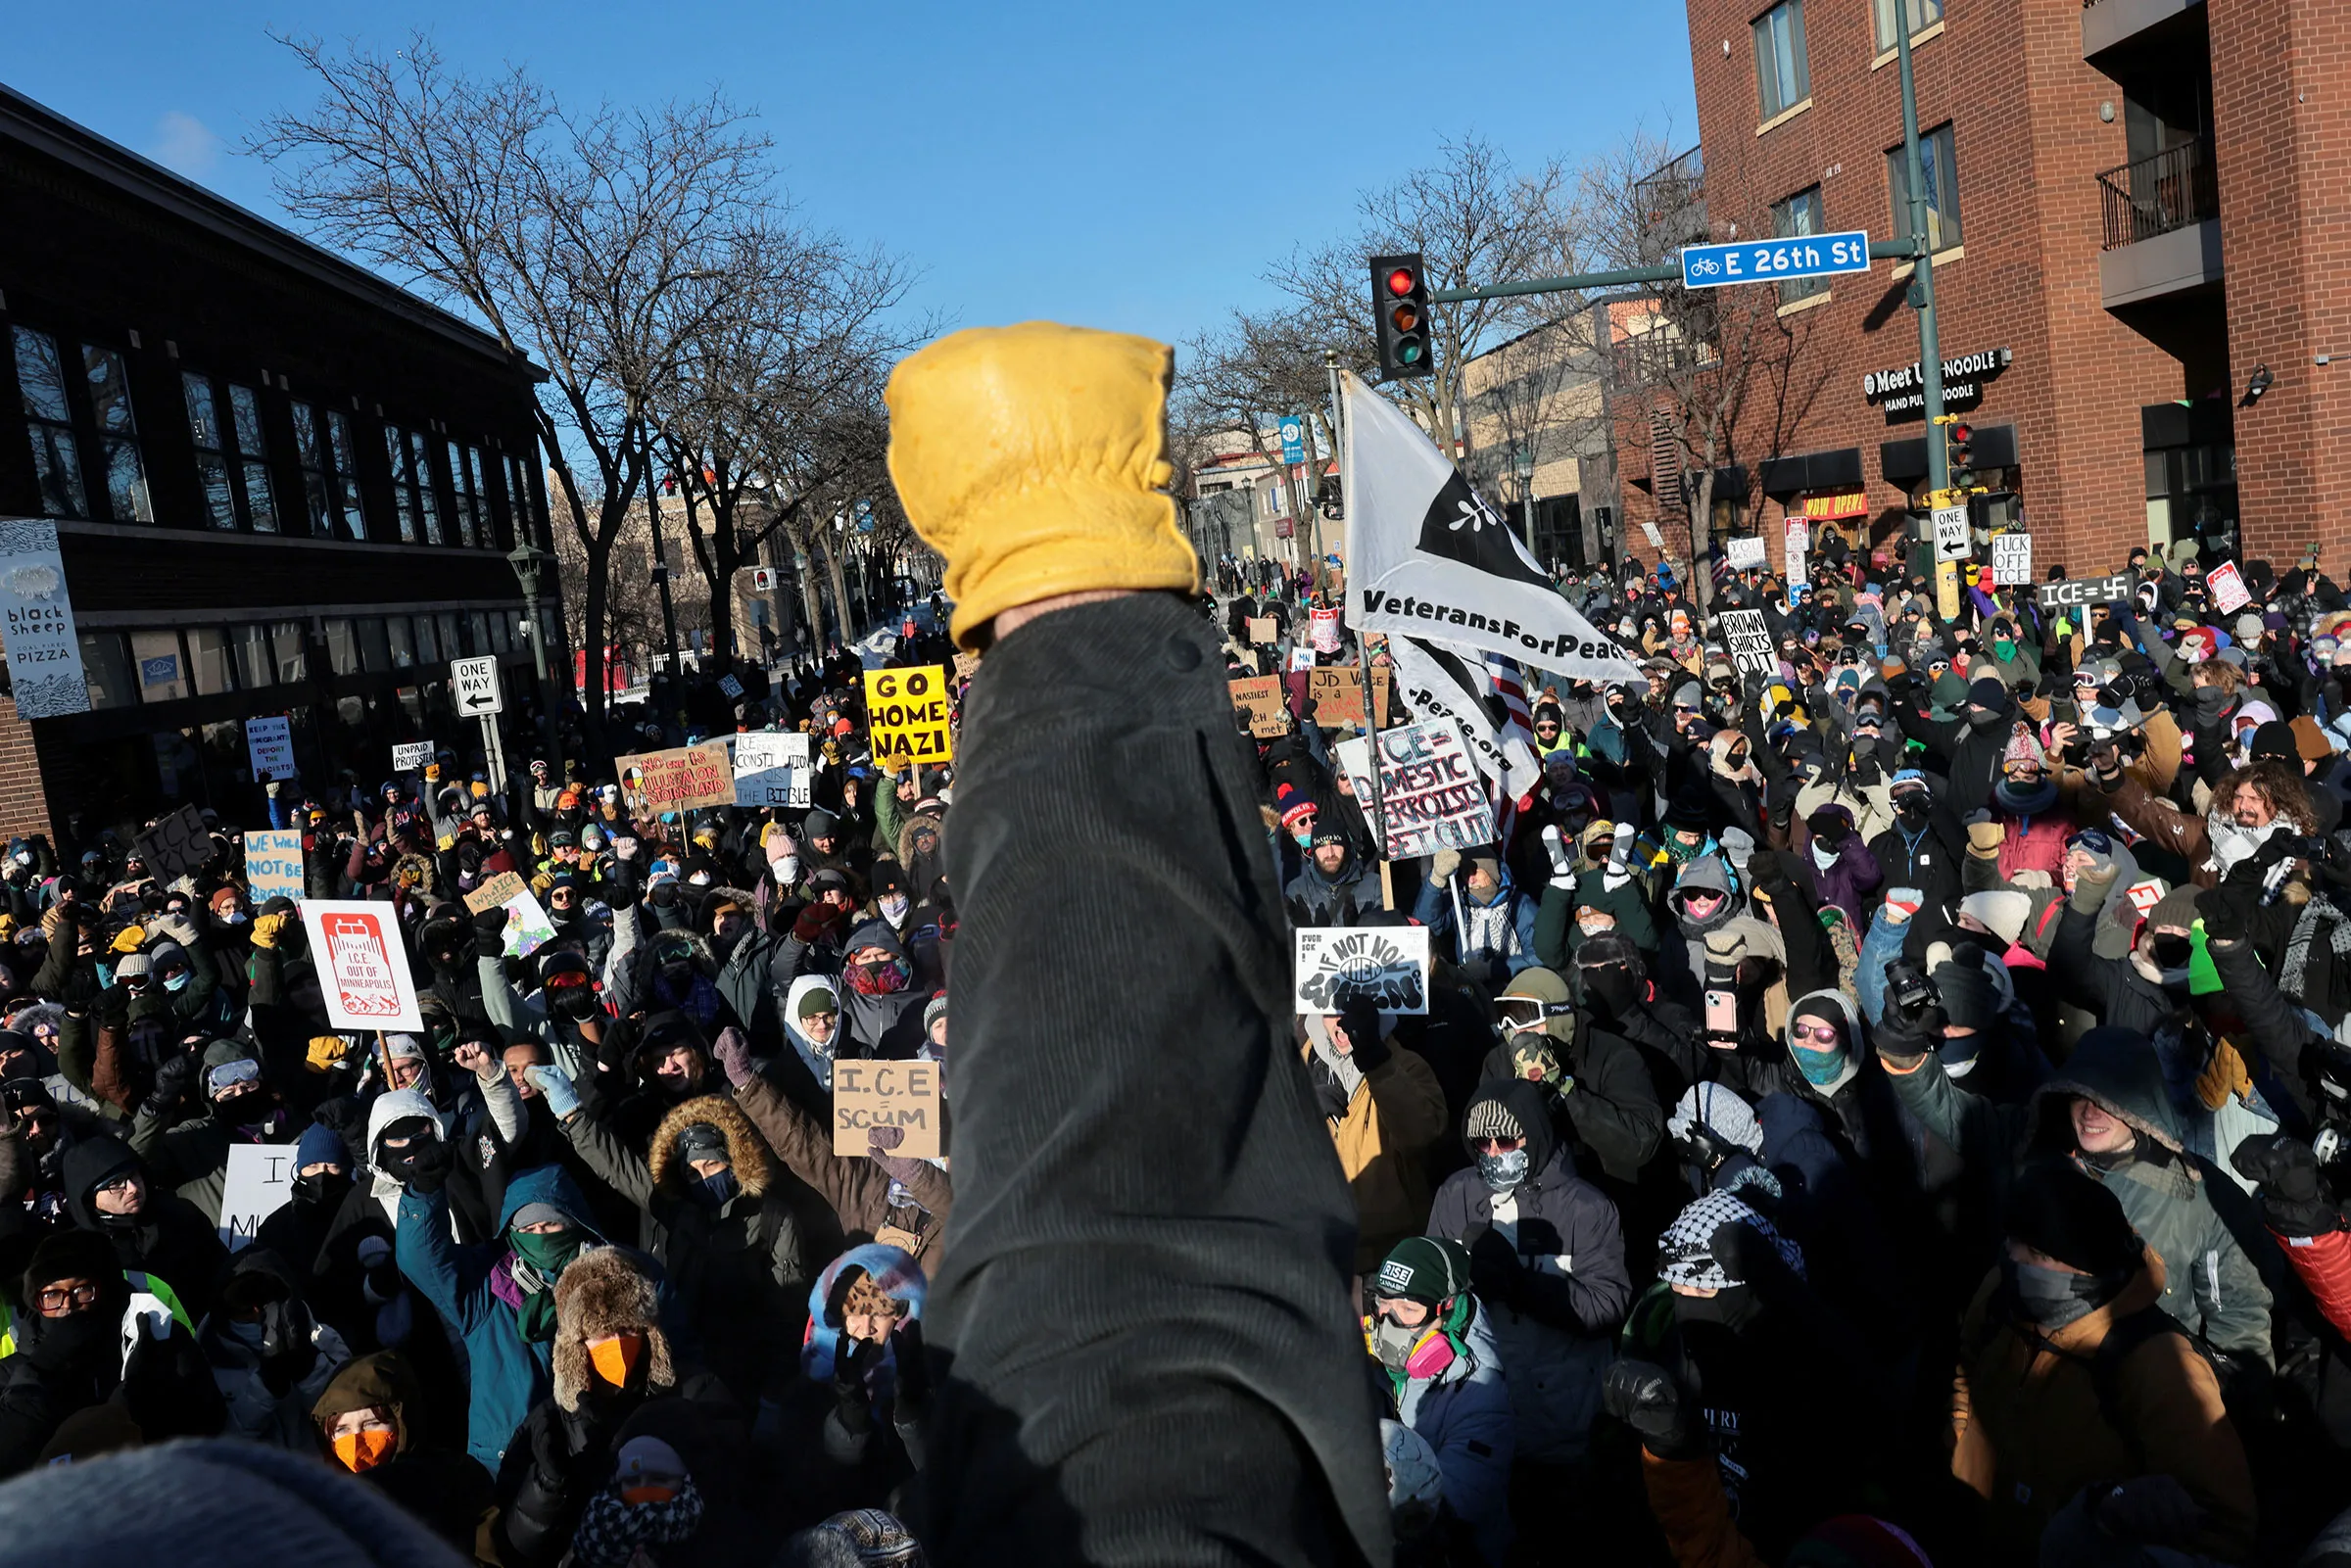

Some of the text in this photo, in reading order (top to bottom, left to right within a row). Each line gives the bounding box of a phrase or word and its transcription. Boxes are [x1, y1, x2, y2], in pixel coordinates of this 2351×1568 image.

[1725, 241, 1861, 275] E 26th St
[1876, 366, 1912, 394] Meet
[1885, 396, 1908, 411] HAND
[1805, 493, 1864, 517] NOW OPEN!
[1939, 511, 1960, 525] ONE
[1940, 524, 1962, 539] WAY
[1994, 536, 2029, 552] FUCK
[1994, 553, 2028, 568] OFF
[1994, 568, 2029, 583] ICE
[8, 605, 64, 623] black
[11, 623, 66, 636] sheep
[1722, 612, 1765, 636] BROWN
[1729, 633, 1771, 653] SHIRTS
[17, 648, 70, 664] PIZZA
[1737, 650, 1773, 674] OUT
[460, 662, 488, 677] ONE
[1315, 670, 1340, 687] JD
[461, 677, 490, 691] WAY
[877, 674, 929, 697] GO
[1235, 689, 1269, 702] NASTIEST
[869, 700, 944, 727] HOME
[1261, 724, 1282, 735] met
[398, 743, 428, 755] UNPAID
[737, 736, 756, 751] ICE
[874, 730, 945, 759] NAZI
[642, 756, 664, 772] NO
[689, 752, 706, 766] IS
[696, 765, 719, 781] ON
[687, 780, 725, 799] LAND
[738, 786, 809, 804] THE BIBLE
[141, 806, 202, 858] ICE
[246, 834, 302, 853] WE WILL
[157, 833, 212, 881] KYS
[248, 859, 303, 878] NOT BE
[497, 873, 517, 891] ICE
[1319, 953, 1339, 972] IF
[1332, 933, 1368, 961] NOT
[346, 966, 378, 977] OUT OF
[340, 978, 392, 989] MINNEAPOLIS
[839, 1069, 931, 1097] I.C.E
[1383, 1264, 1410, 1281] RISE
